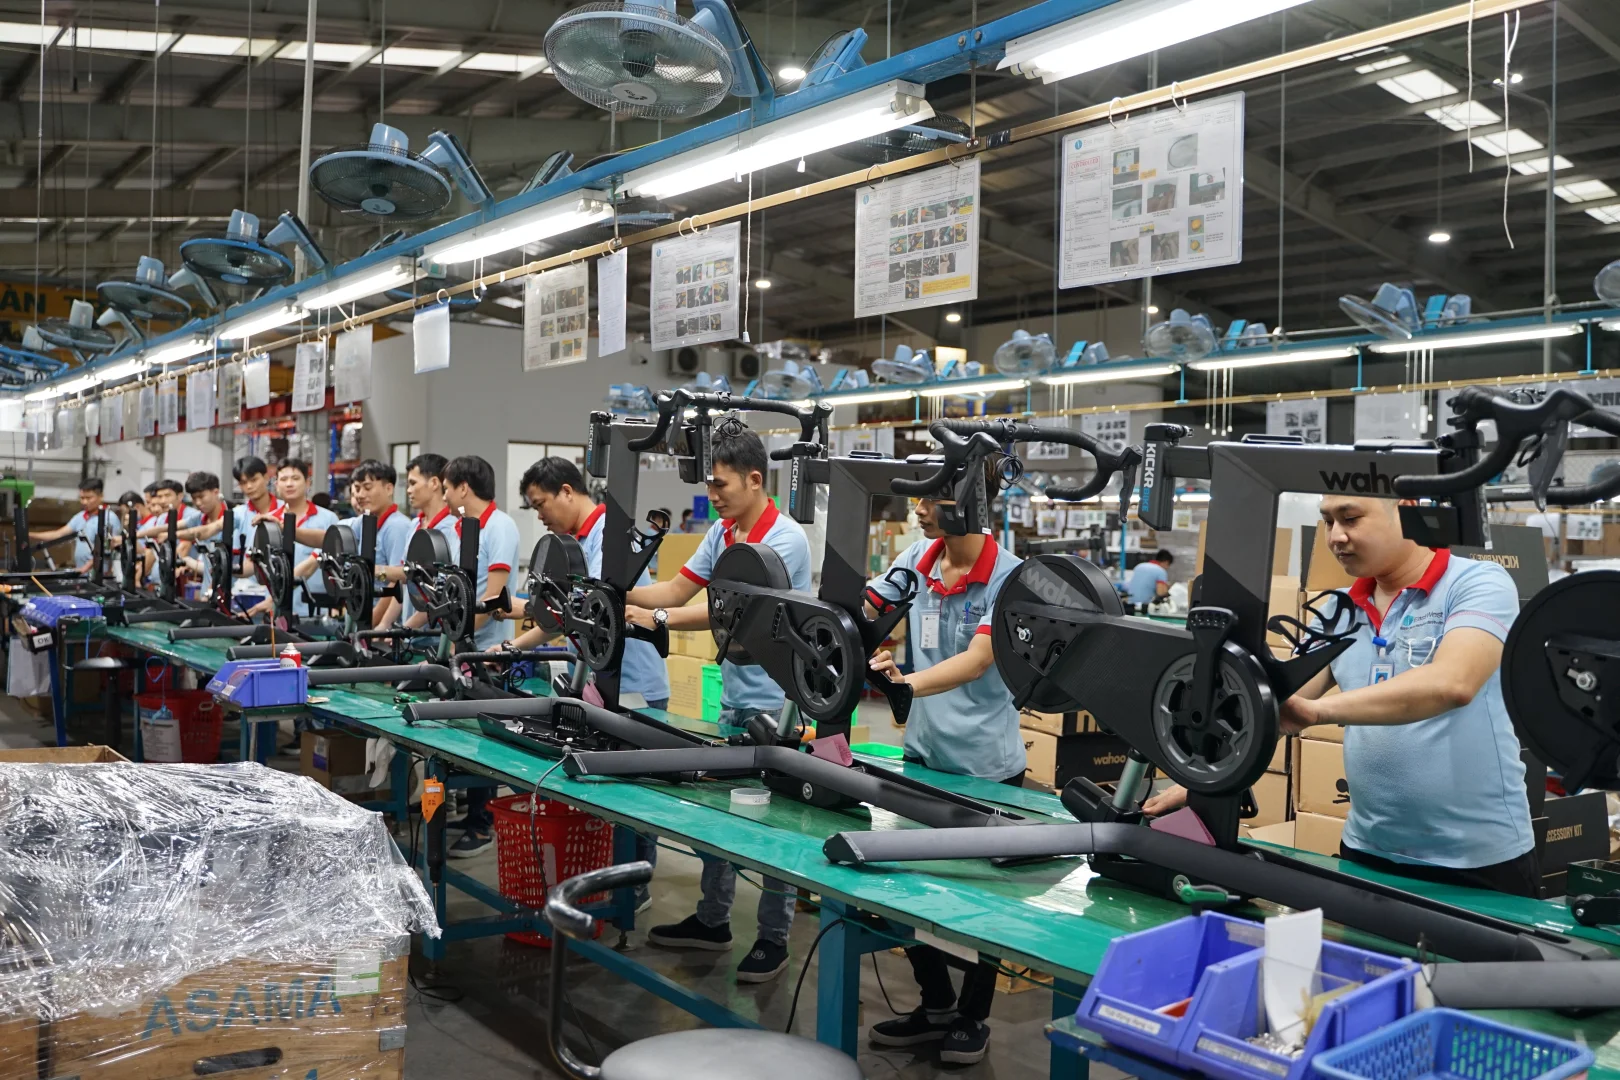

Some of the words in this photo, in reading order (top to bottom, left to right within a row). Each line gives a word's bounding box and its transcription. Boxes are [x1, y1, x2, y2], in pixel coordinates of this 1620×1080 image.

[790, 456, 800, 491] KICKR
[1143, 443, 1157, 488] KICKR
[1319, 461, 1398, 494] wah
[1093, 752, 1127, 765] wahoo
[141, 975, 342, 1040] ASAMA
